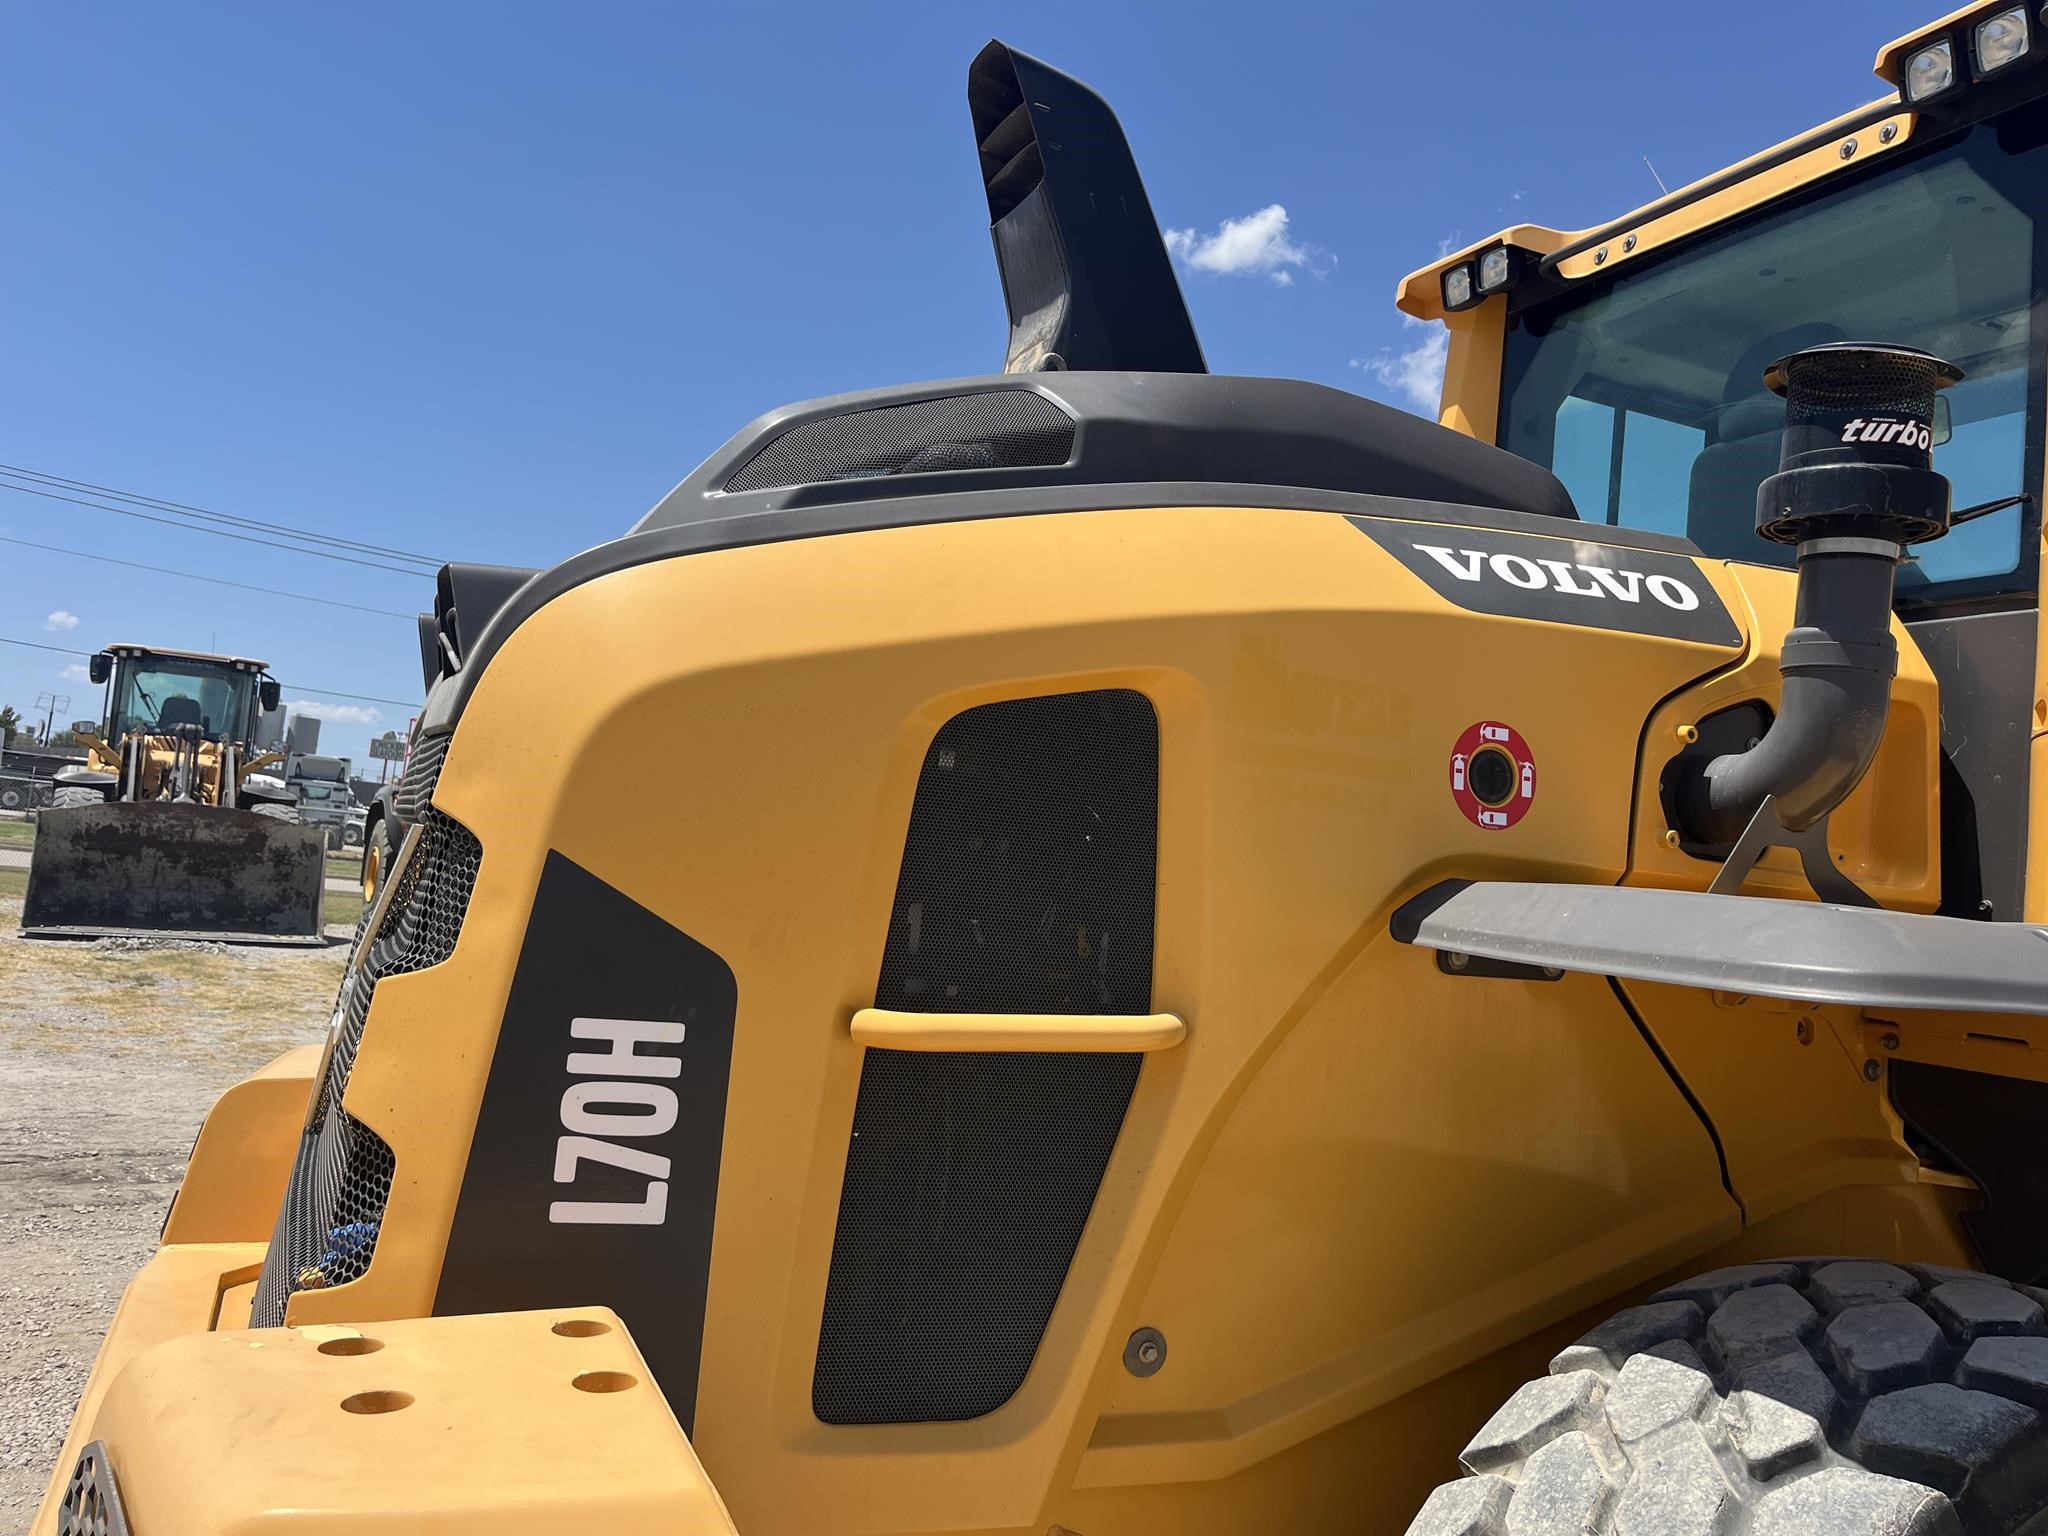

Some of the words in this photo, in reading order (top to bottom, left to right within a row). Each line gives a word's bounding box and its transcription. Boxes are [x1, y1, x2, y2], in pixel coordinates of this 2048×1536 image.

[1841, 418, 1929, 450] turbo
[1411, 543, 1700, 611] VOLVO
[549, 1017, 686, 1225] L70H
